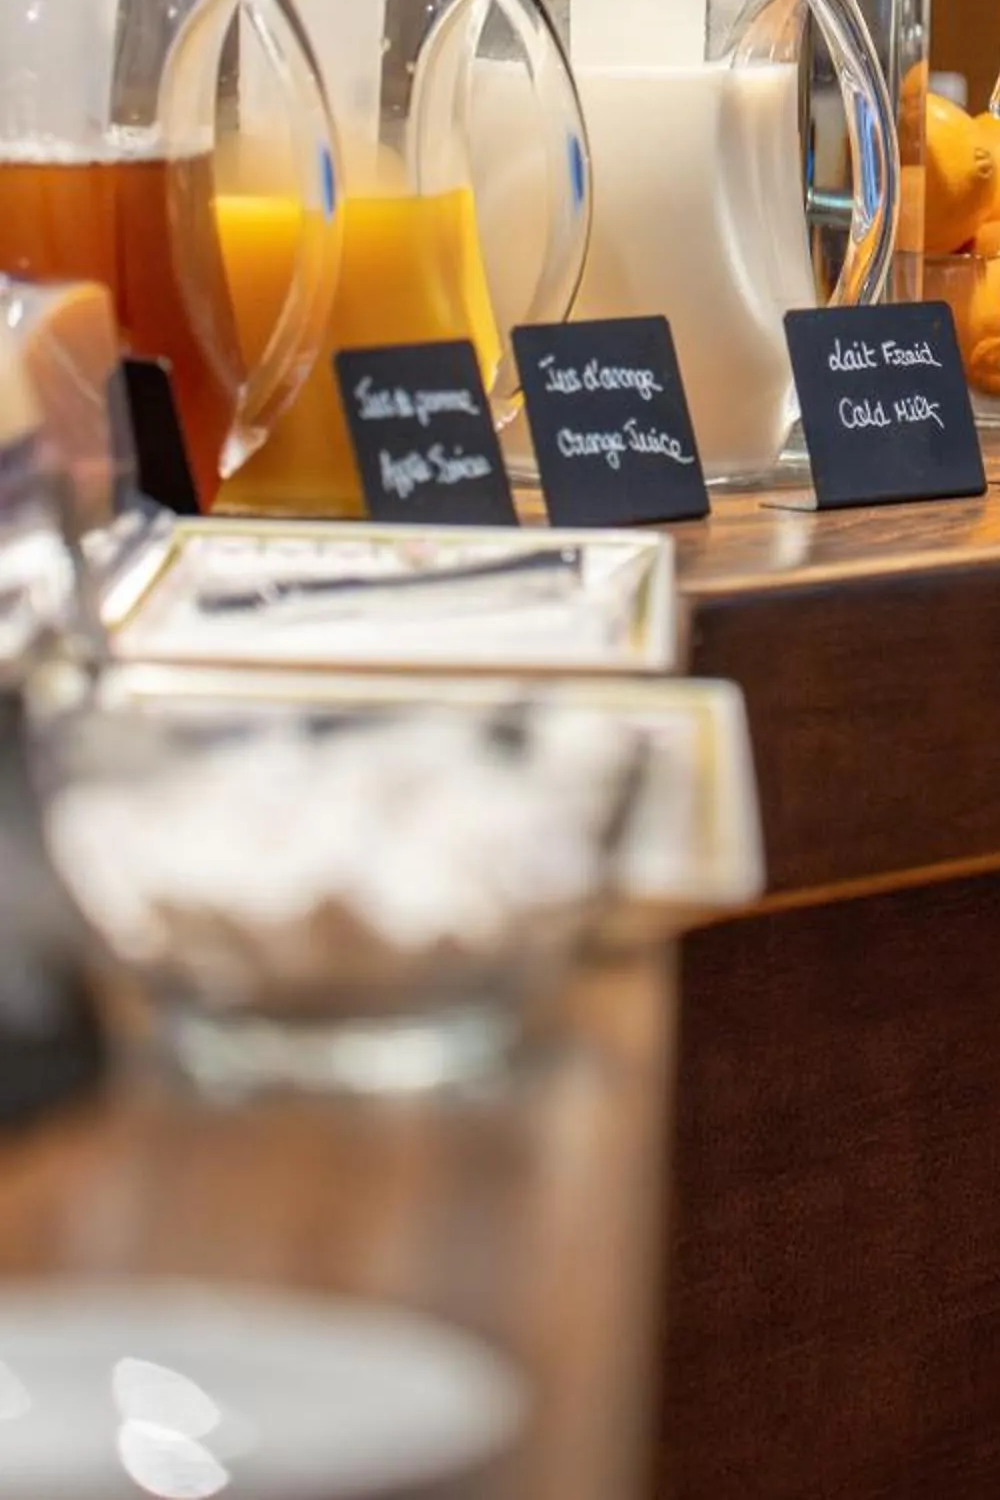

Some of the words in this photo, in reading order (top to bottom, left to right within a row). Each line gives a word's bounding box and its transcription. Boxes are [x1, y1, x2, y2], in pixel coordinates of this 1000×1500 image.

[881, 340, 943, 368] Froid
[538, 354, 582, 394] Jus
[581, 357, 664, 401] d'orange
[838, 397, 891, 429] Cold
[894, 395, 945, 429] Milk
[557, 427, 627, 470] Orange
[623, 417, 695, 464] Juice
